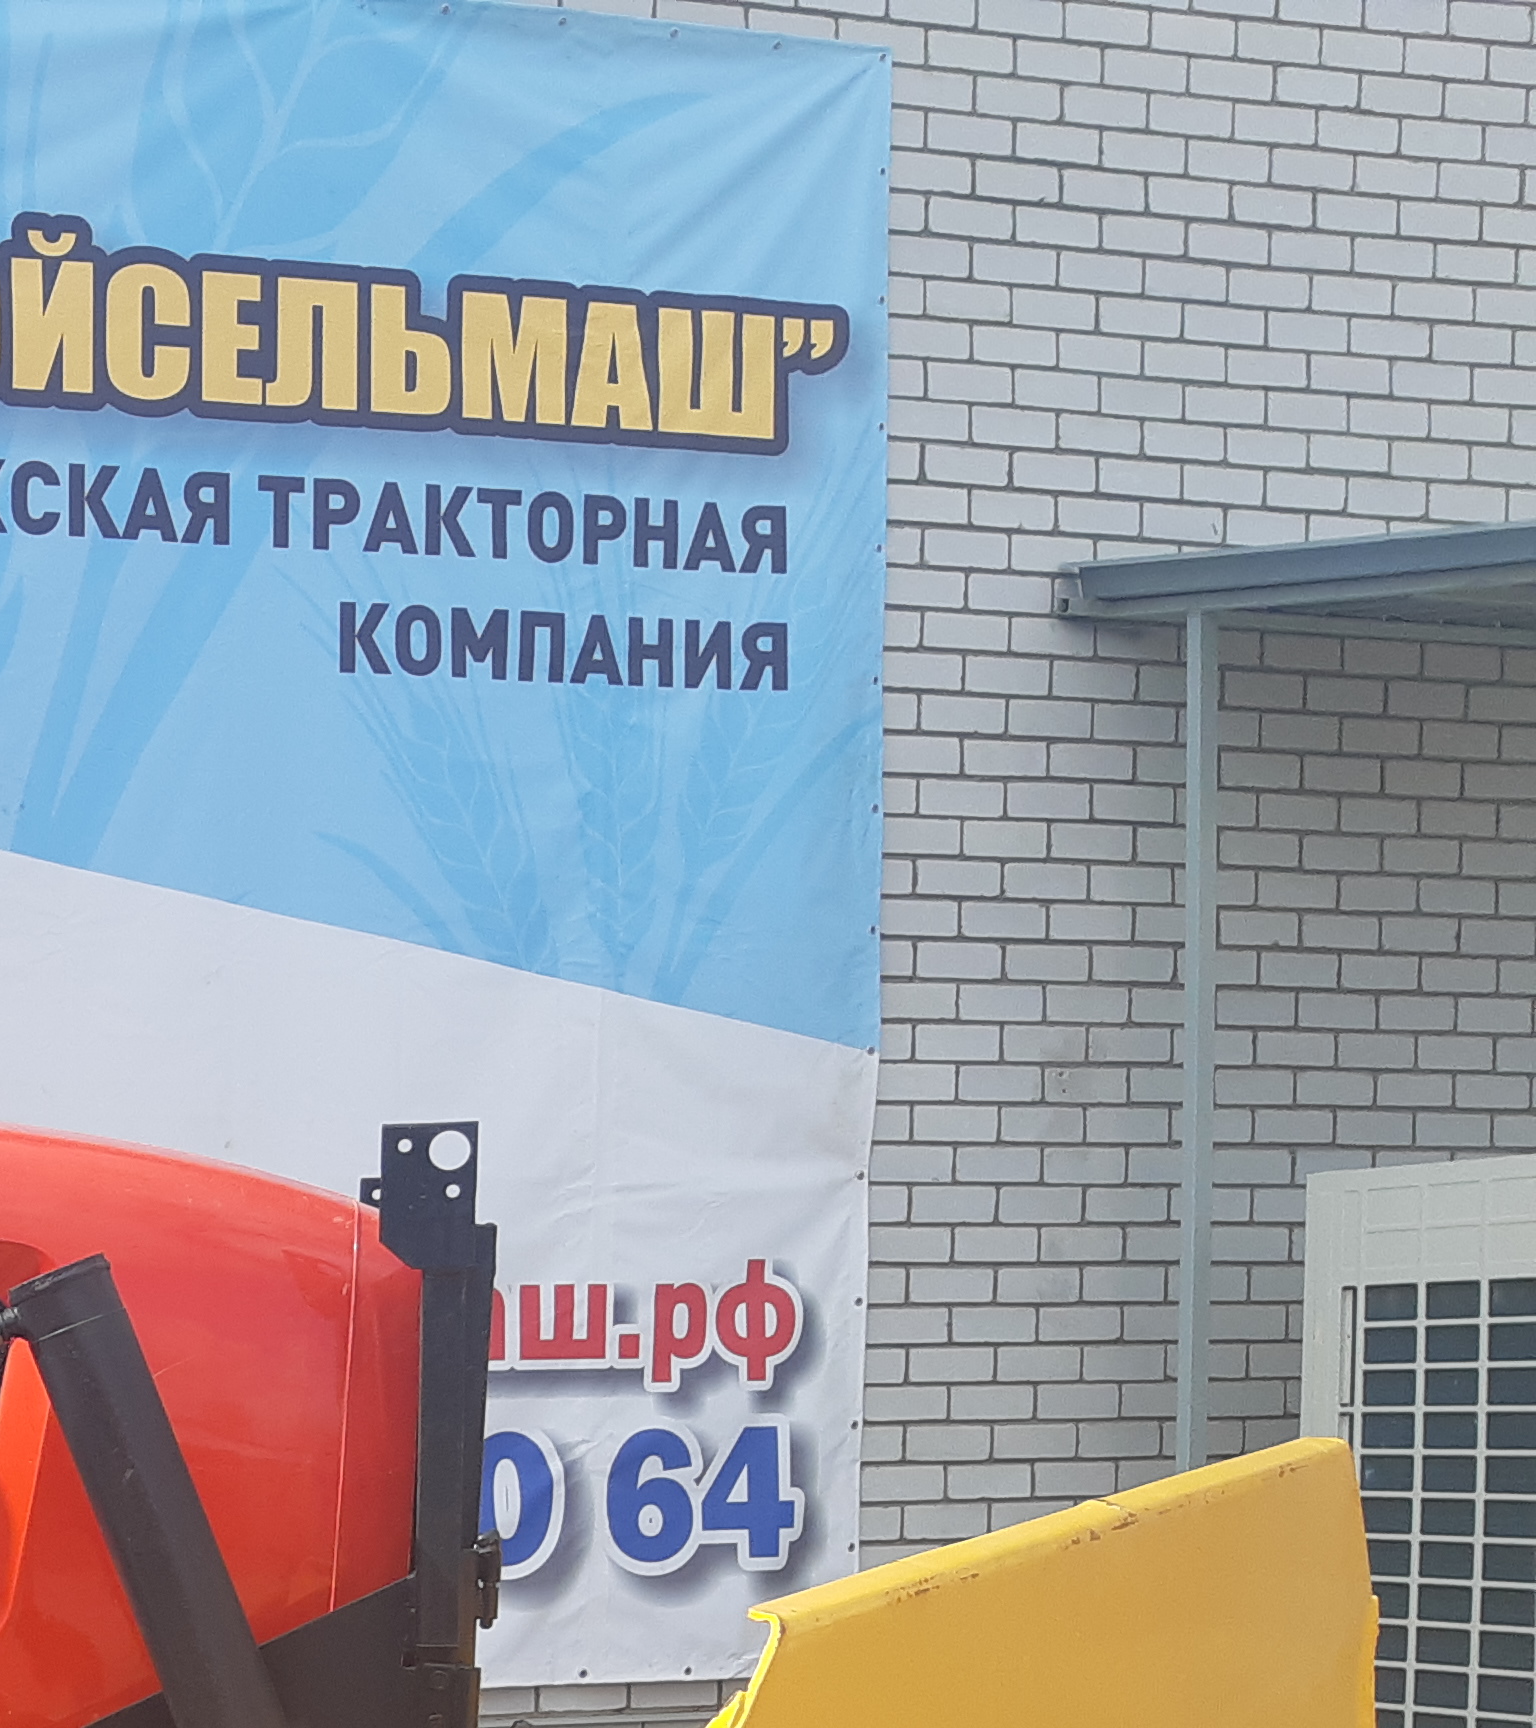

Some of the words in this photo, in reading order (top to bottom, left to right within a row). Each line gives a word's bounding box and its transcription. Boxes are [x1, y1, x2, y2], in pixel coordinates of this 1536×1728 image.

[258, 472, 789, 575] ТРАКТОРНАЯ
[339, 601, 789, 692] КОМПАНИЯ
[488, 1258, 797, 1383] ш.рф
[606, 1426, 796, 1563] 64
